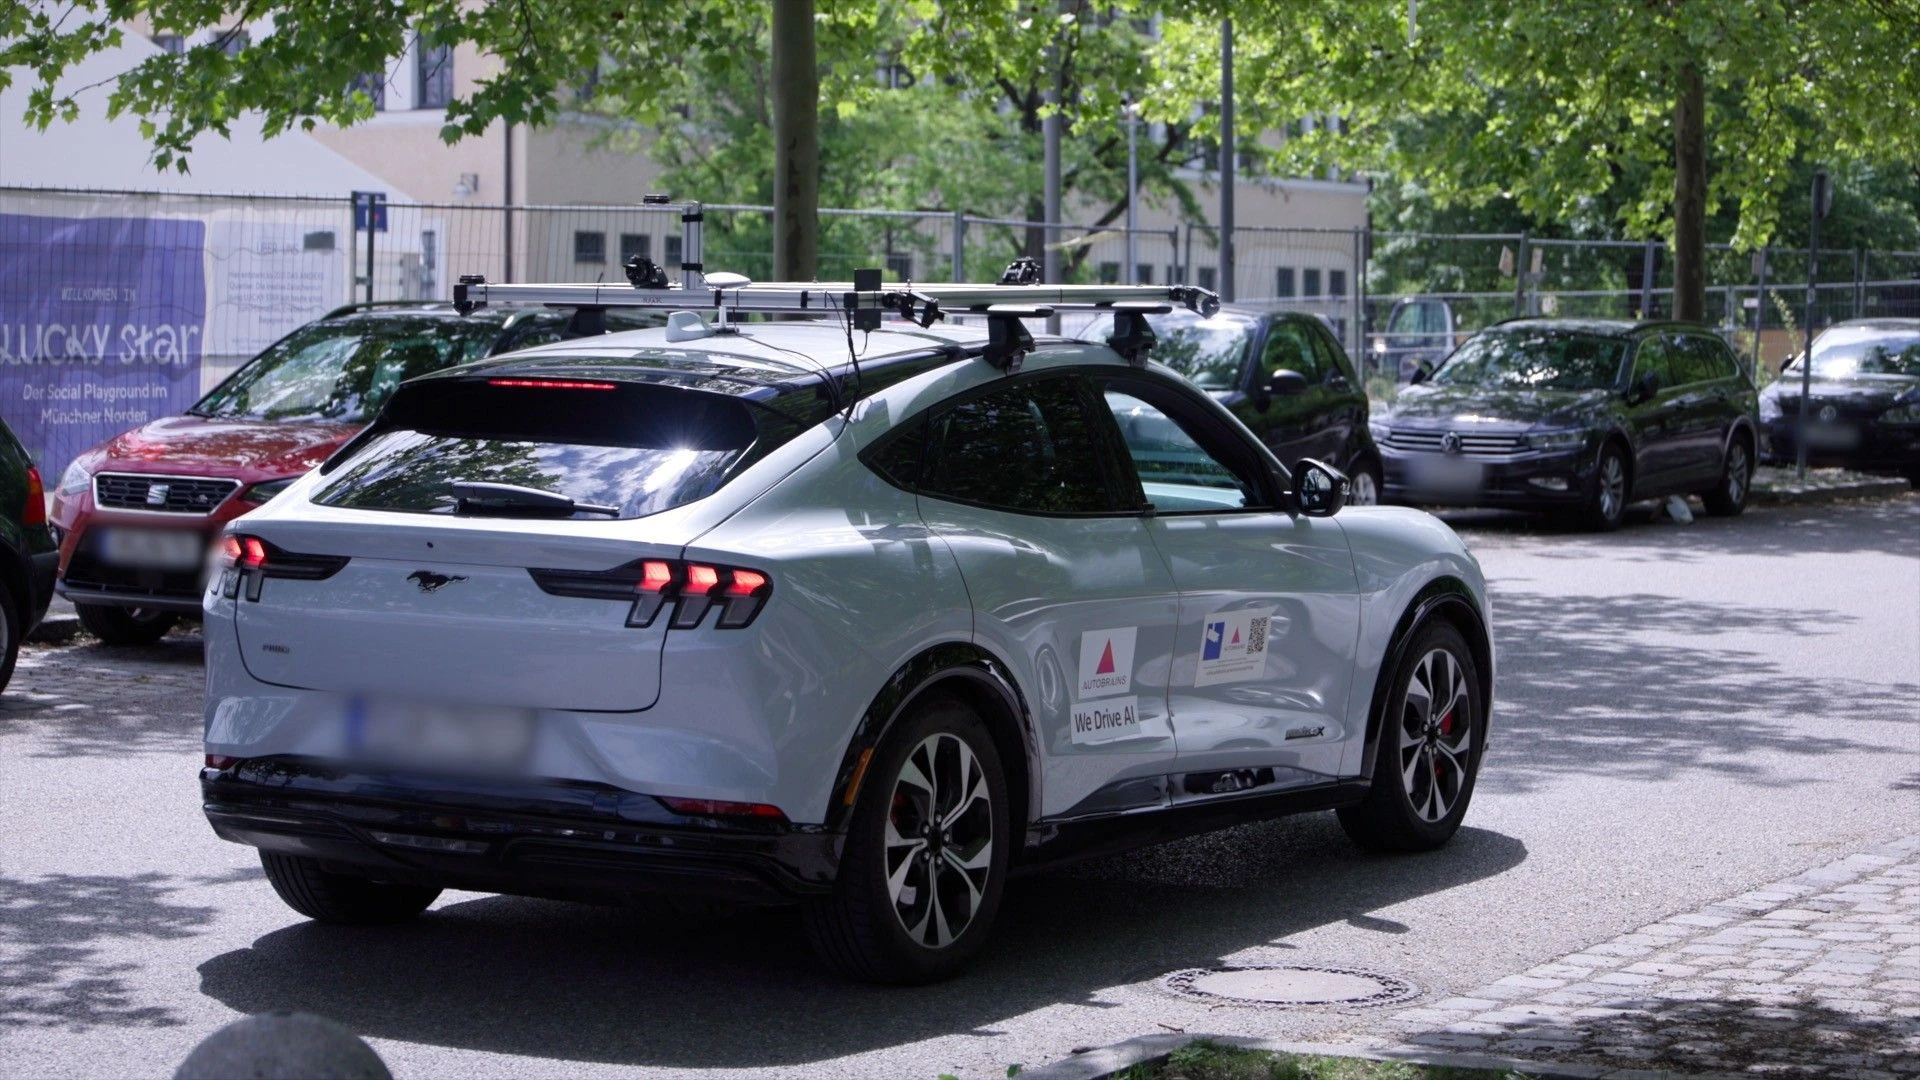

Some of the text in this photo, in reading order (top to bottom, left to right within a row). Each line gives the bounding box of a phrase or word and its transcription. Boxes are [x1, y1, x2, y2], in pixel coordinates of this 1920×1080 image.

[61, 287, 118, 301] WILLKOMMEN
[23, 383, 168, 403] Der Social Playground im
[41, 407, 147, 425] Münchner Norden
[1082, 675, 1127, 691] AUTOBRAINS
[1074, 705, 1136, 733] We Drive AI
